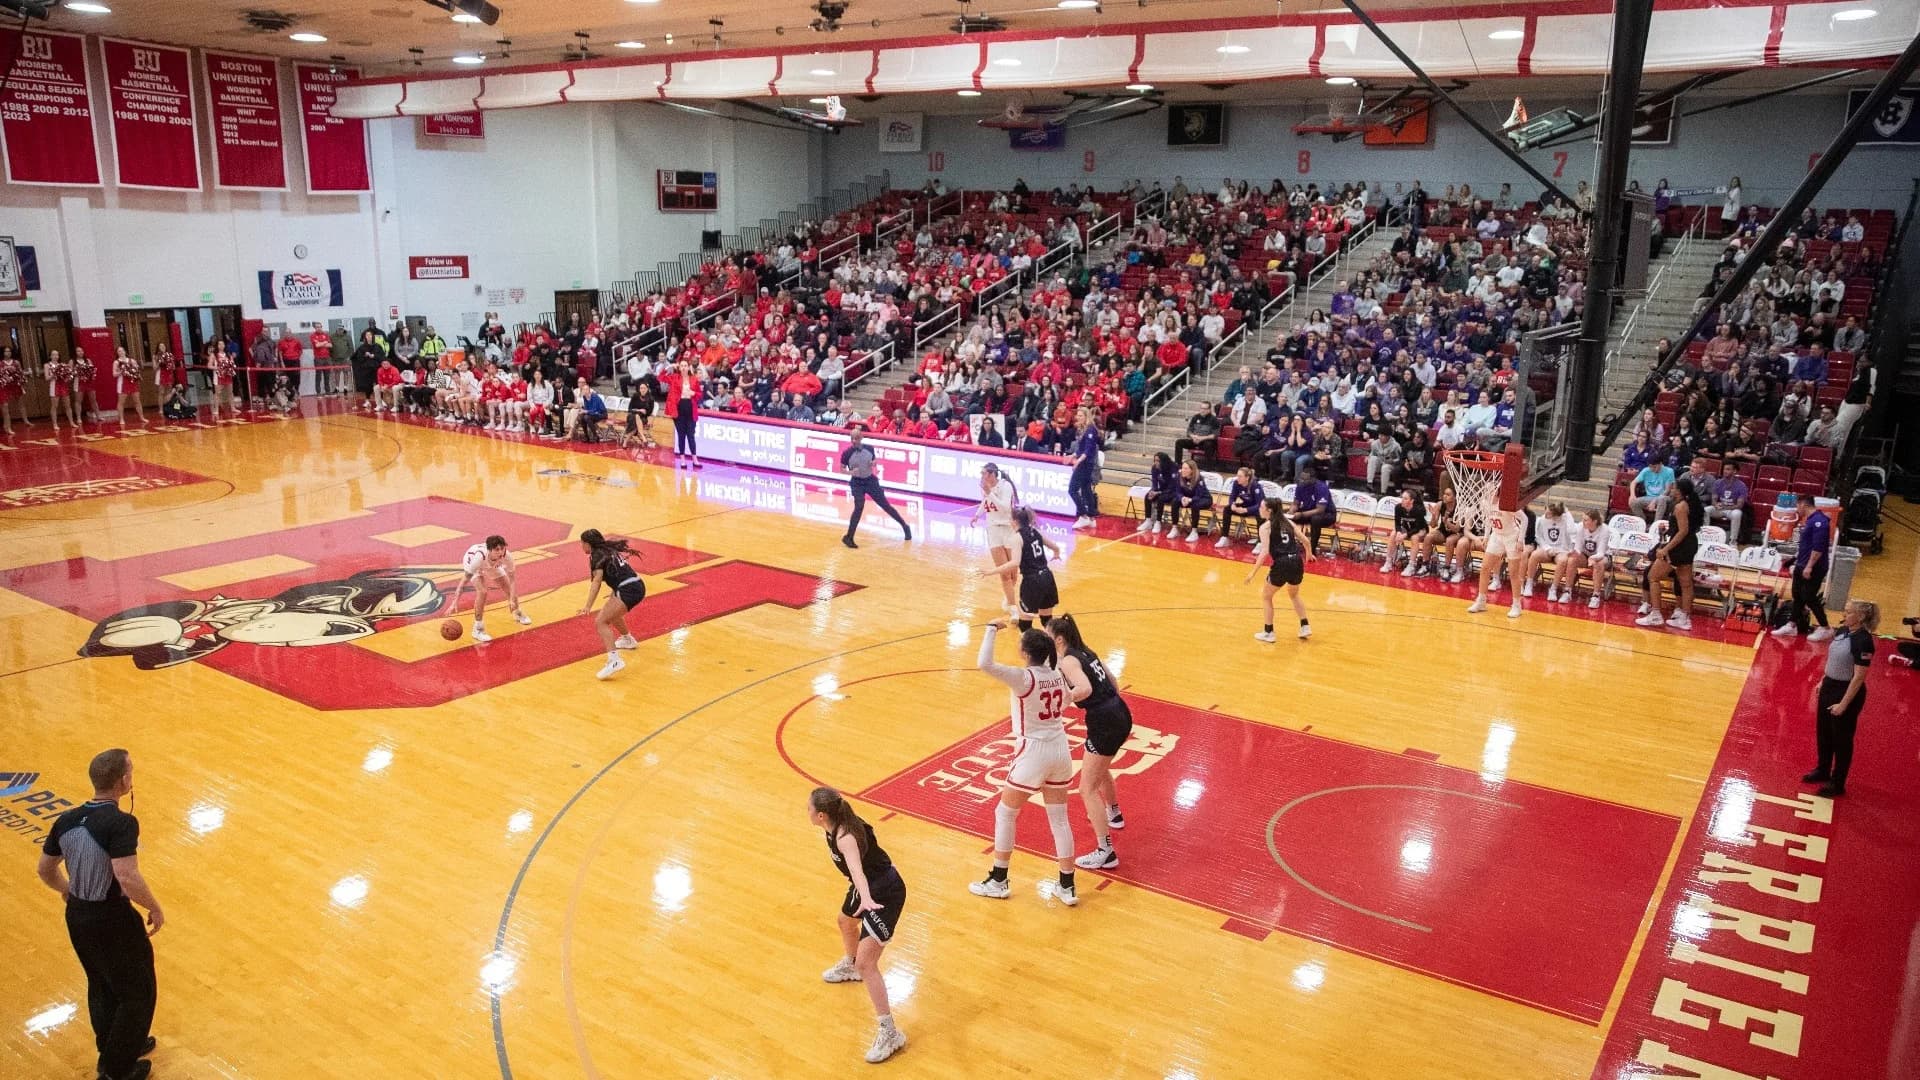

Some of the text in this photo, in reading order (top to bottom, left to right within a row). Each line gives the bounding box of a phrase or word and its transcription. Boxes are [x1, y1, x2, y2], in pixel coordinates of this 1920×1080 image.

[16, 59, 63, 71] WOMEN'S
[221, 61, 262, 73] BOSTON
[128, 71, 170, 83] WOMEN'S
[212, 72, 272, 86] UNIVERSITY
[0, 80, 86, 95] EGULAR SEASON
[121, 79, 179, 93] BASKETBALL
[226, 85, 262, 95] WOMEN'S
[304, 83, 332, 93] UNIVE
[14, 92, 74, 104] CHAMPIONS
[122, 91, 181, 105] CONFERENCE
[220, 94, 269, 105] BASKETBALL
[1, 101, 89, 117] 1988 2009 2012
[126, 101, 179, 114] CHAMPIONS
[3, 111, 31, 121] 2023
[115, 110, 139, 120] 1988
[169, 116, 192, 126] 2003
[928, 151, 945, 172] 10
[1083, 151, 1095, 172] 9
[1297, 150, 1311, 174] 8
[1553, 152, 1568, 177] 7
[425, 257, 445, 265] Follow
[704, 423, 785, 450] NEXEN TIRE
[739, 449, 785, 464] we got you
[1026, 468, 1069, 492] TIRE
[1026, 490, 1045, 502] got
[1047, 494, 1068, 507] you
[984, 500, 998, 512] 44
[1280, 531, 1290, 544] 5
[1031, 540, 1042, 558] 13
[1038, 689, 1063, 720] 33
[0, 804, 43, 836] REDIT
